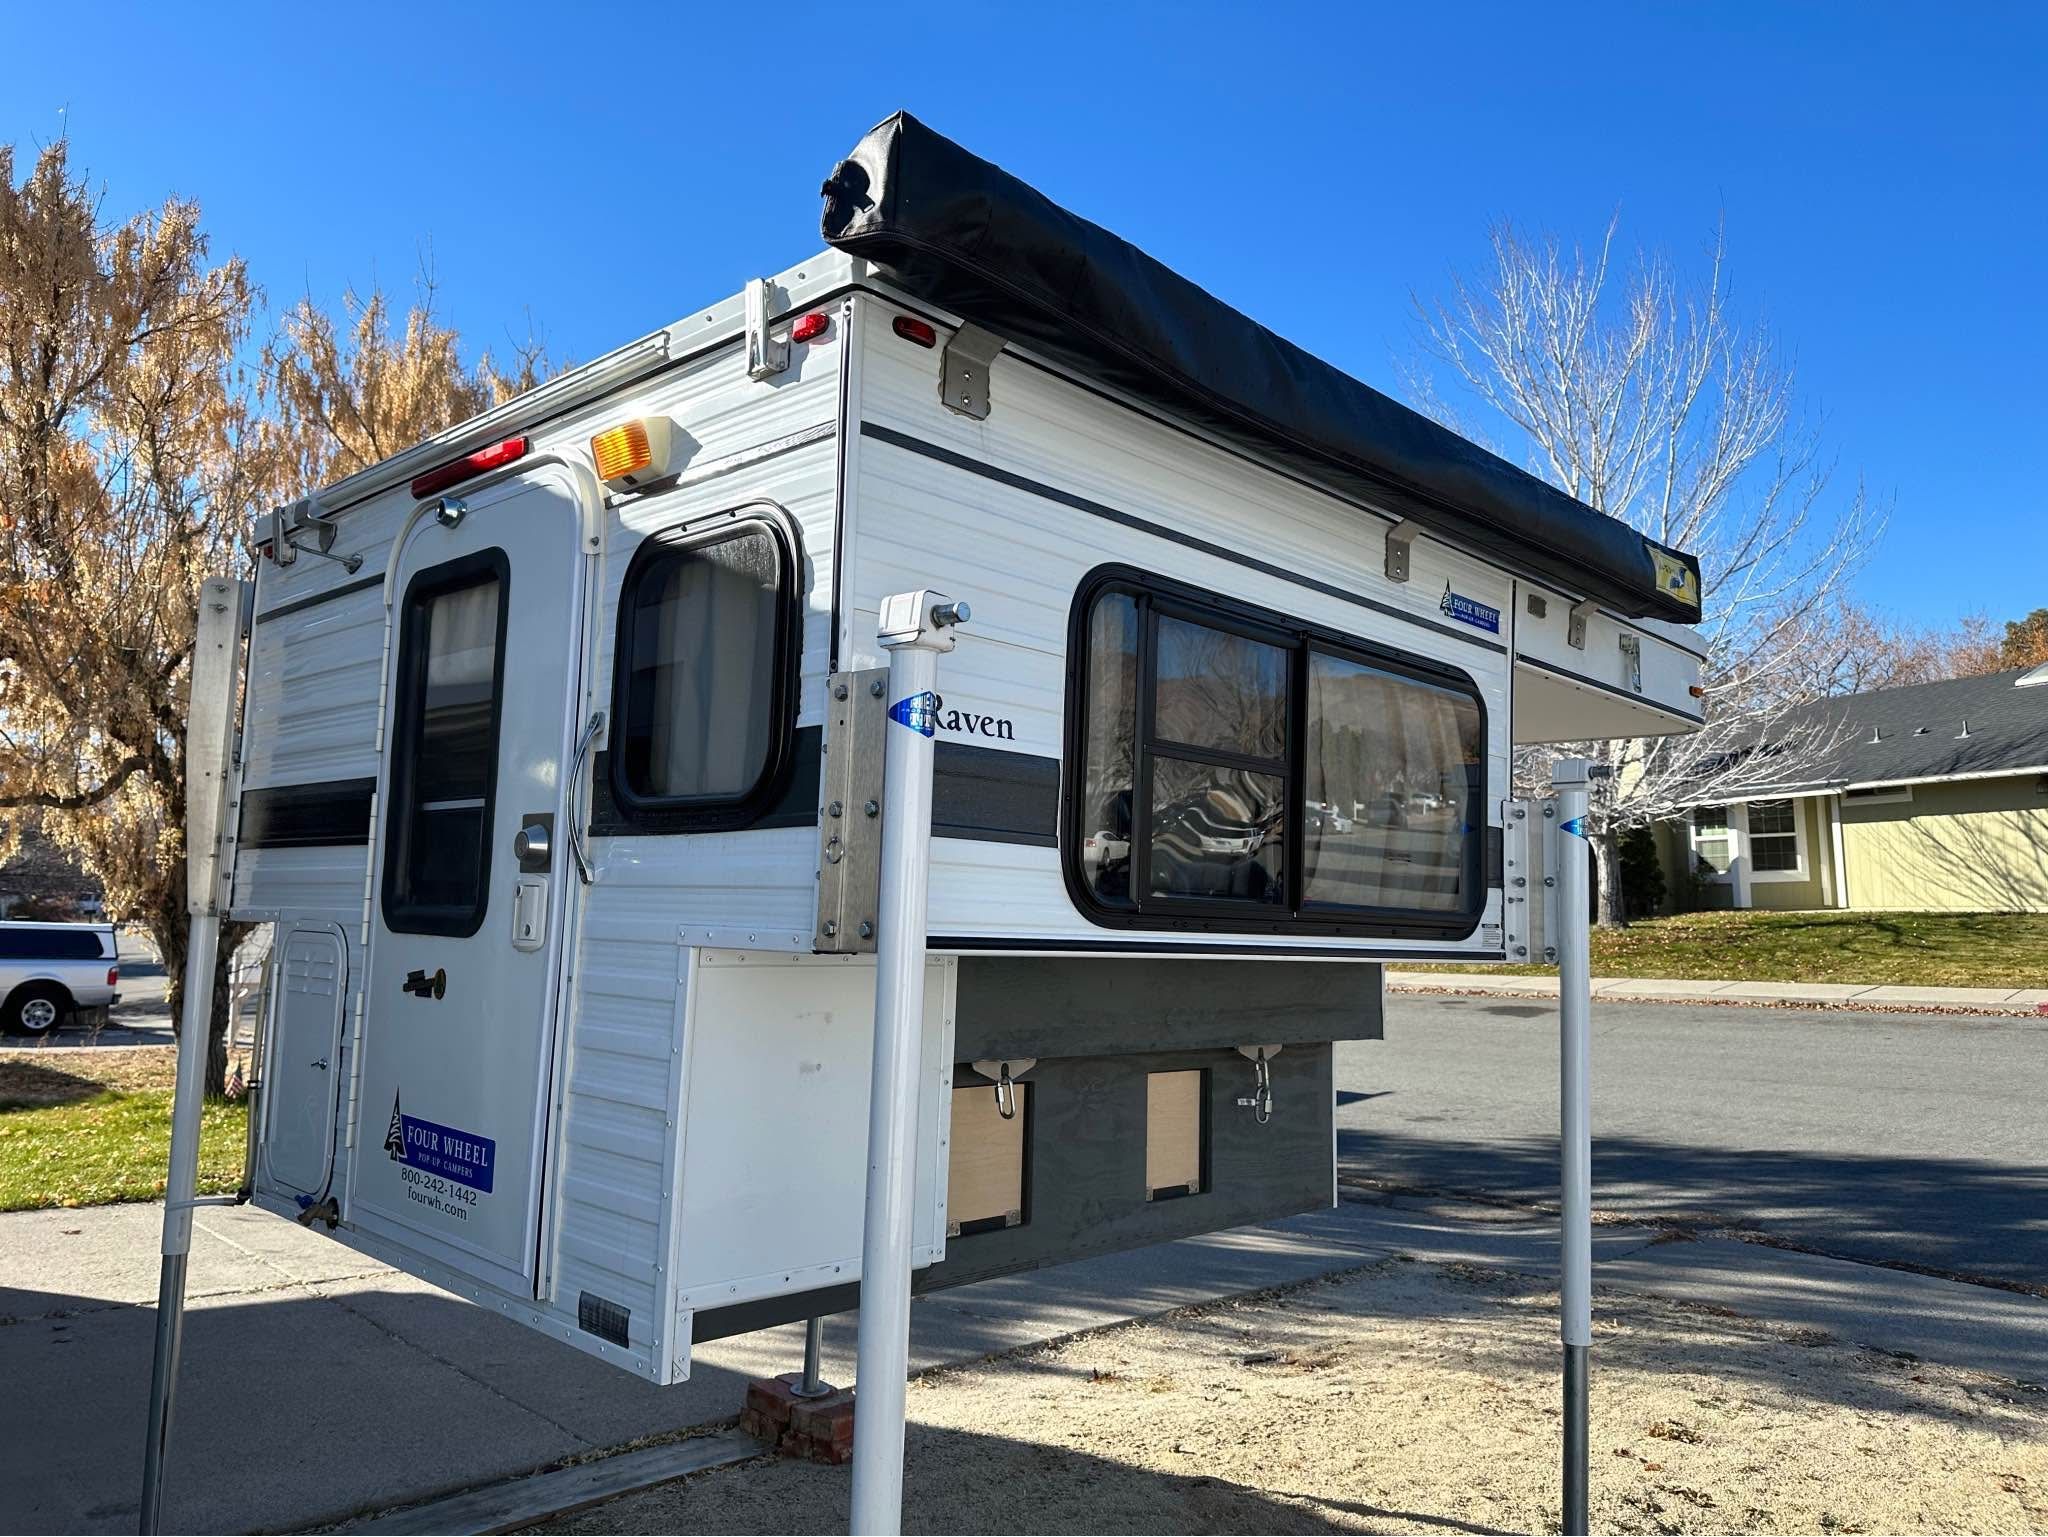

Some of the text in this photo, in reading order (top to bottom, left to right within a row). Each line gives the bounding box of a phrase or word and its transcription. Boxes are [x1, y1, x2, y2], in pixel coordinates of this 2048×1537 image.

[1454, 599, 1472, 614] FOUR
[1474, 606, 1496, 623] WHEEL
[407, 1125, 489, 1167] FOUR WHEEL
[401, 1167, 478, 1207] 800-242-1442
[443, 1160, 473, 1178] CAMPERS
[407, 1185, 468, 1221] fourwh.com
